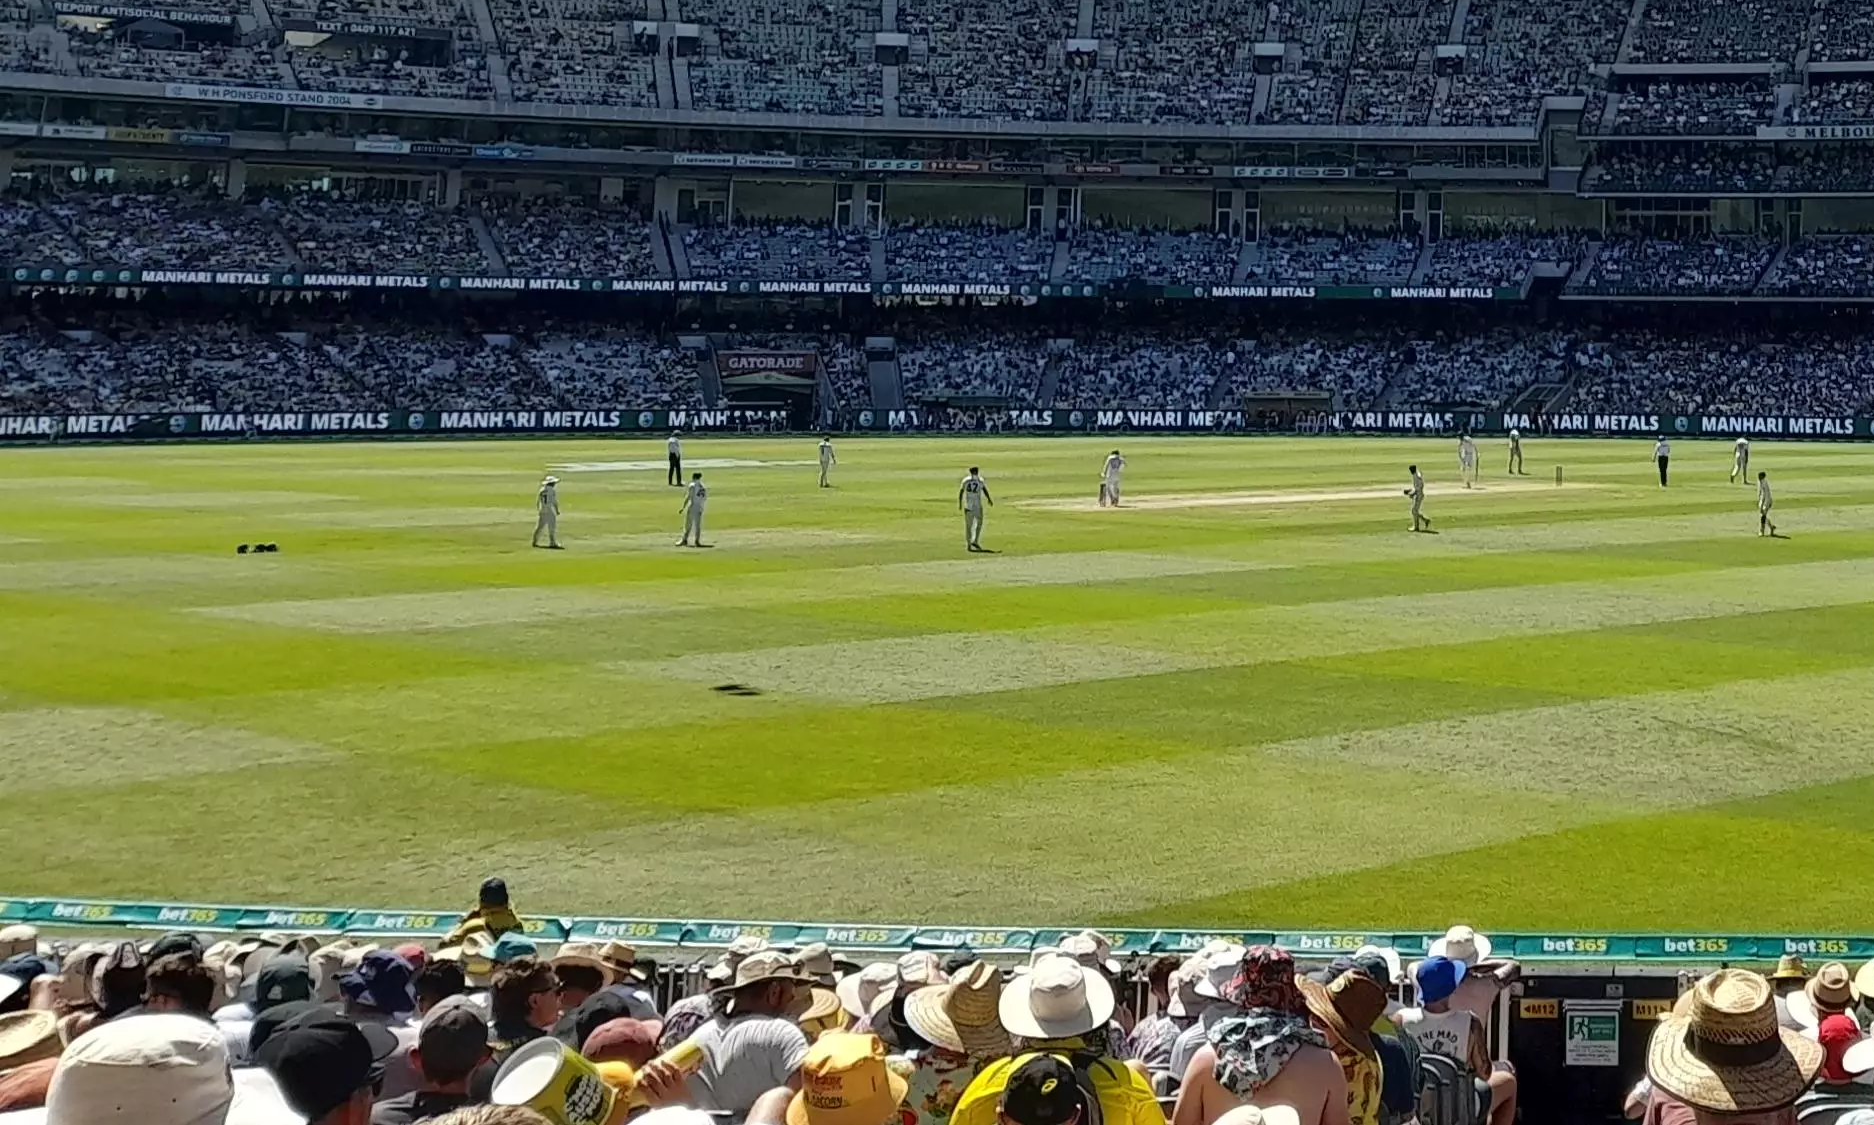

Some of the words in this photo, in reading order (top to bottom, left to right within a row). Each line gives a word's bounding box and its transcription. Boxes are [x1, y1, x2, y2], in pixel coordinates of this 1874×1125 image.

[212, 88, 220, 98] H
[223, 89, 283, 102] PONSFORD
[287, 93, 324, 105] STAND
[141, 270, 212, 283] MANHARI
[215, 272, 270, 285] METALS
[303, 274, 371, 286] MANHARI
[375, 276, 428, 287] METALS
[460, 277, 525, 289] MANHARI
[529, 278, 580, 290] METALS
[612, 280, 674, 291] MANHARI
[678, 280, 728, 292] METALS
[759, 281, 820, 292] MANHARI
[823, 282, 871, 293] METALS
[901, 283, 960, 294] MANHARI
[964, 284, 1010, 295] METALS
[1212, 286, 1268, 297] MANHARI
[1271, 286, 1316, 297] METALS
[1391, 287, 1446, 298] MANHARI
[1449, 287, 1493, 298] METALS
[729, 357, 804, 369] GATORADE
[310, 413, 389, 430] METALS
[440, 412, 536, 428] MANHARI
[543, 411, 620, 428] METALS
[1594, 414, 1659, 431] METALS
[1701, 416, 1783, 433] MANHARI
[1789, 417, 1854, 434] METALS
[52, 903, 112, 918] bet365
[157, 906, 217, 922] bet365
[265, 910, 327, 926] bet365
[374, 913, 436, 928] bet365
[595, 921, 657, 937] bet365
[826, 927, 888, 943] bet365
[942, 929, 1005, 945] bet365
[1301, 934, 1364, 950] bet365
[1543, 937, 1607, 952] bet365
[1664, 937, 1728, 952] bet365
[1784, 938, 1848, 954] bet365
[1531, 1003, 1555, 1014] M12
[1636, 1004, 1658, 1015] M11
